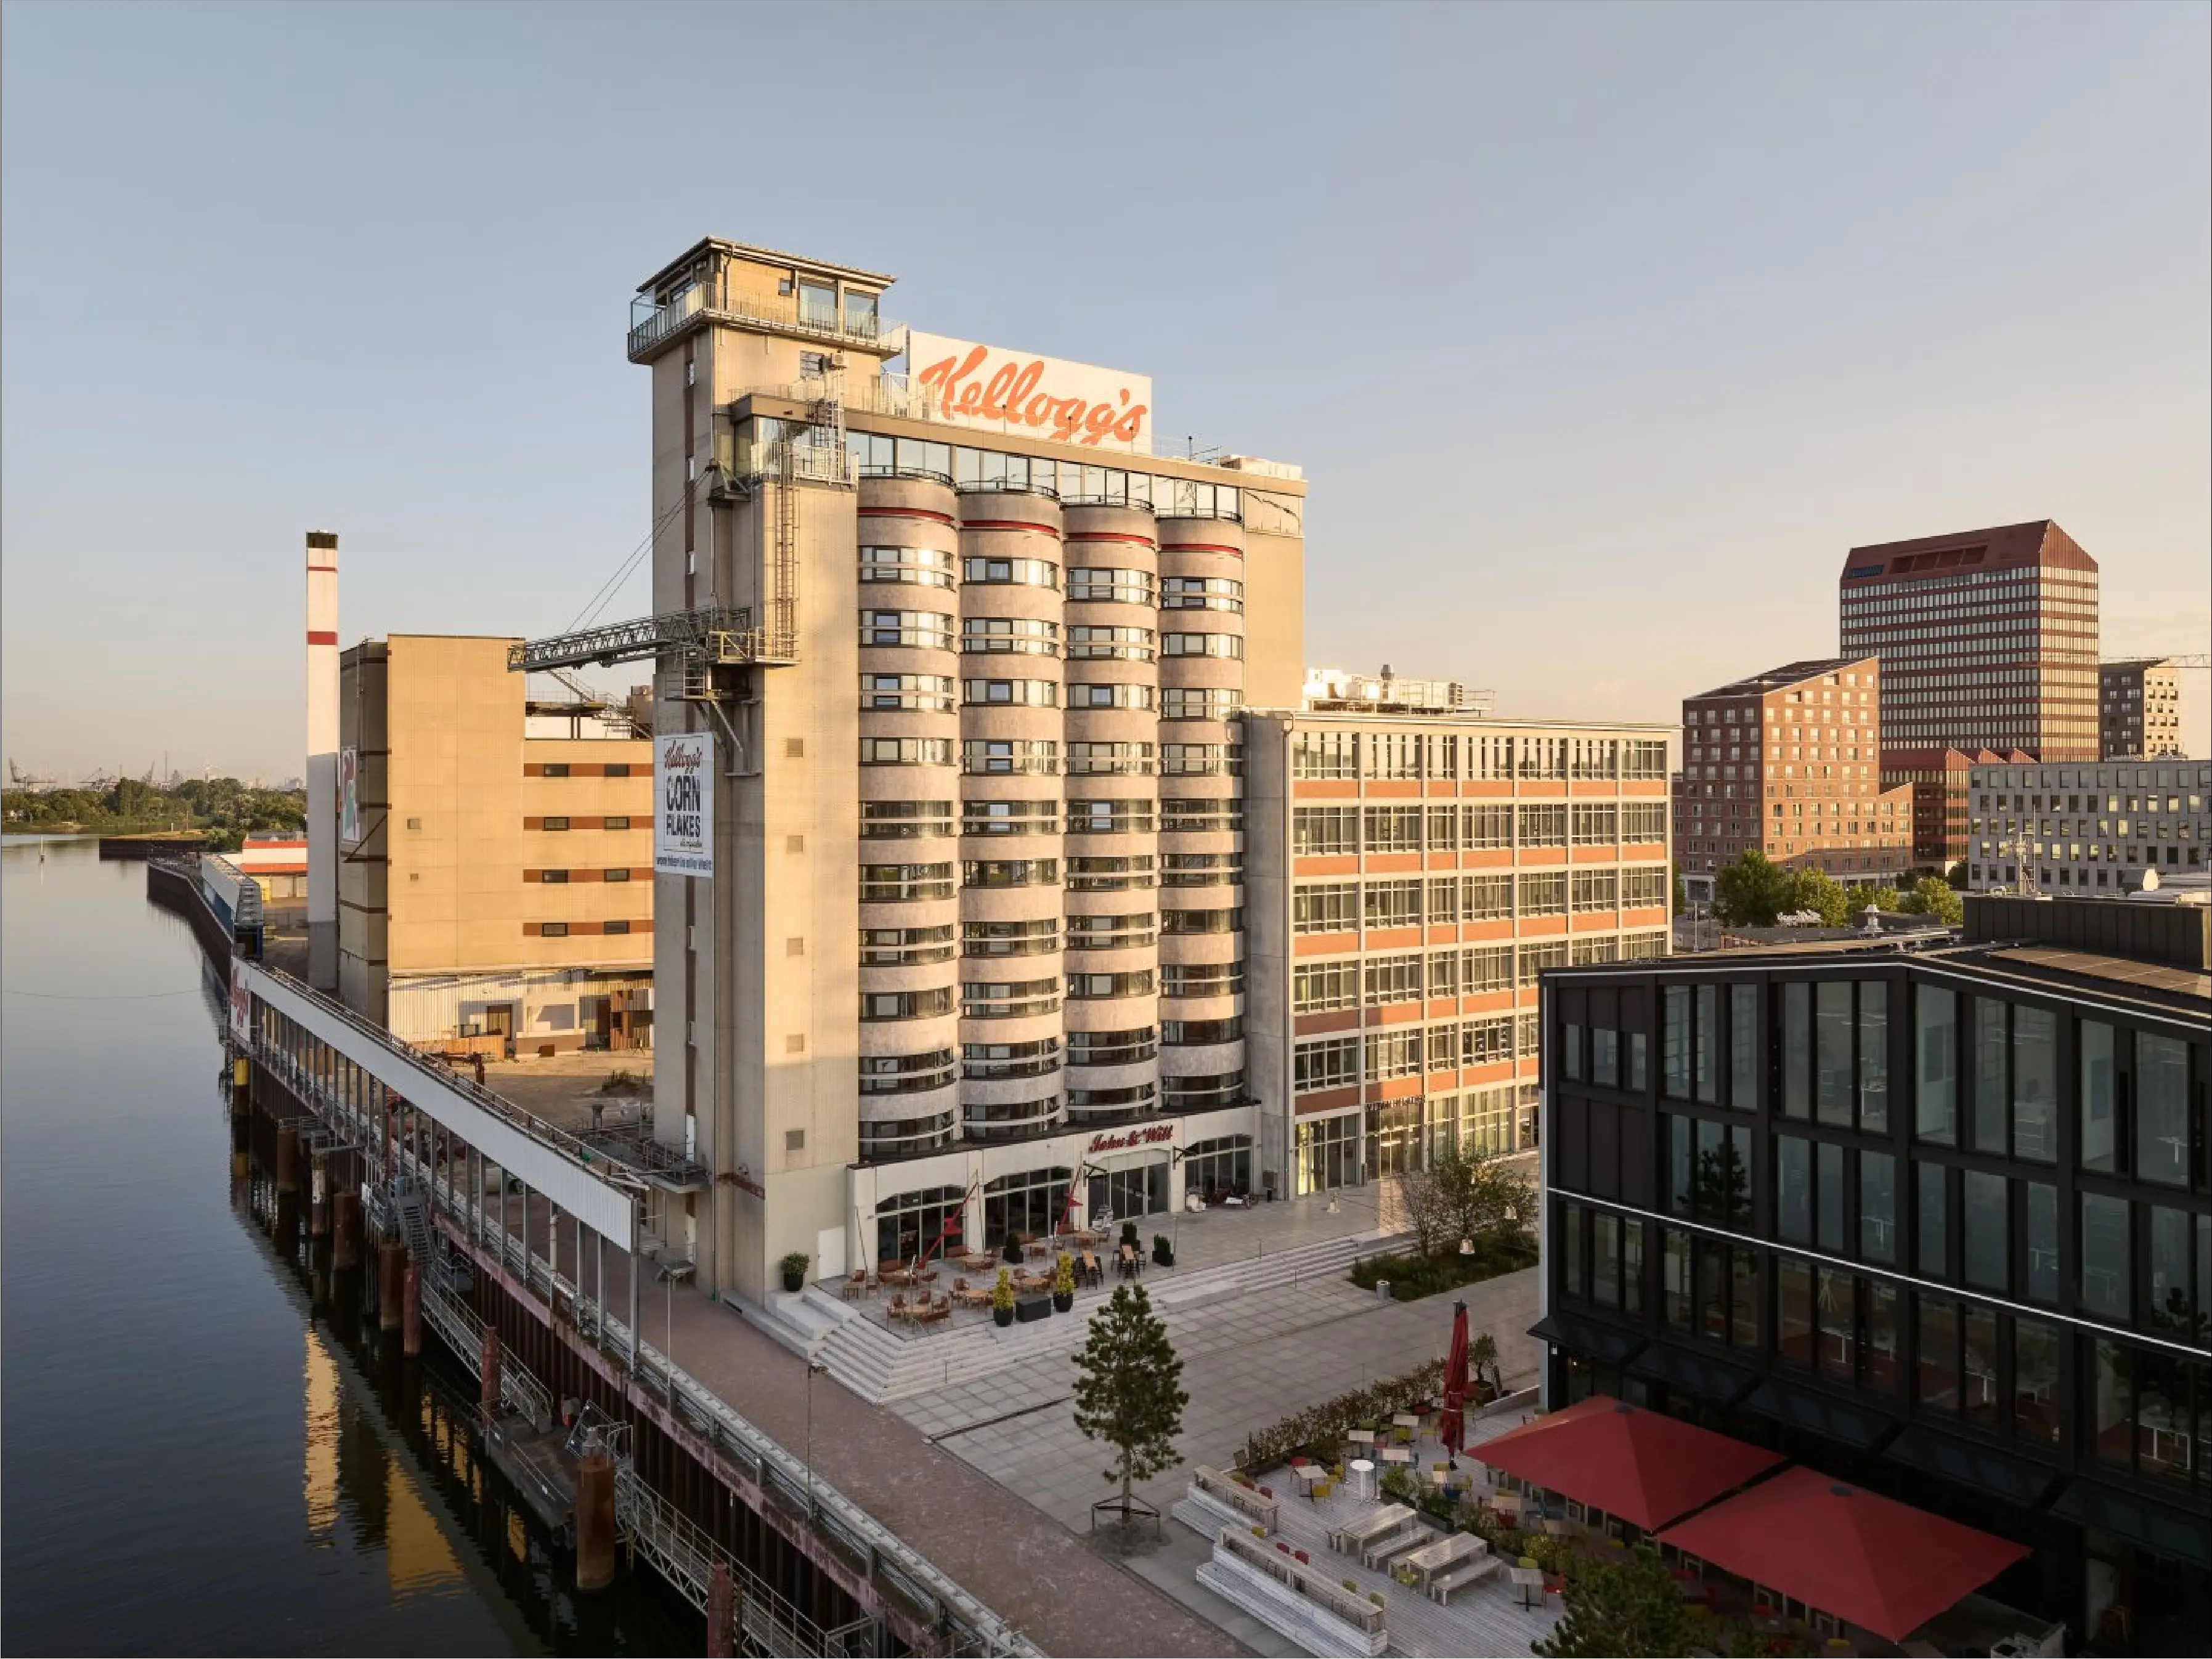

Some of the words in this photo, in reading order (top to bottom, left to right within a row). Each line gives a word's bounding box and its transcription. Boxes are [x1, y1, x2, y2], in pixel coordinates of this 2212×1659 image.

[919, 345, 1148, 445] Kellogg's
[665, 740, 702, 774] Kellogg's
[666, 775, 701, 811] CORN
[666, 813, 701, 838] FLAKES
[1089, 1134, 1126, 1153] John
[1128, 1130, 1141, 1146] &
